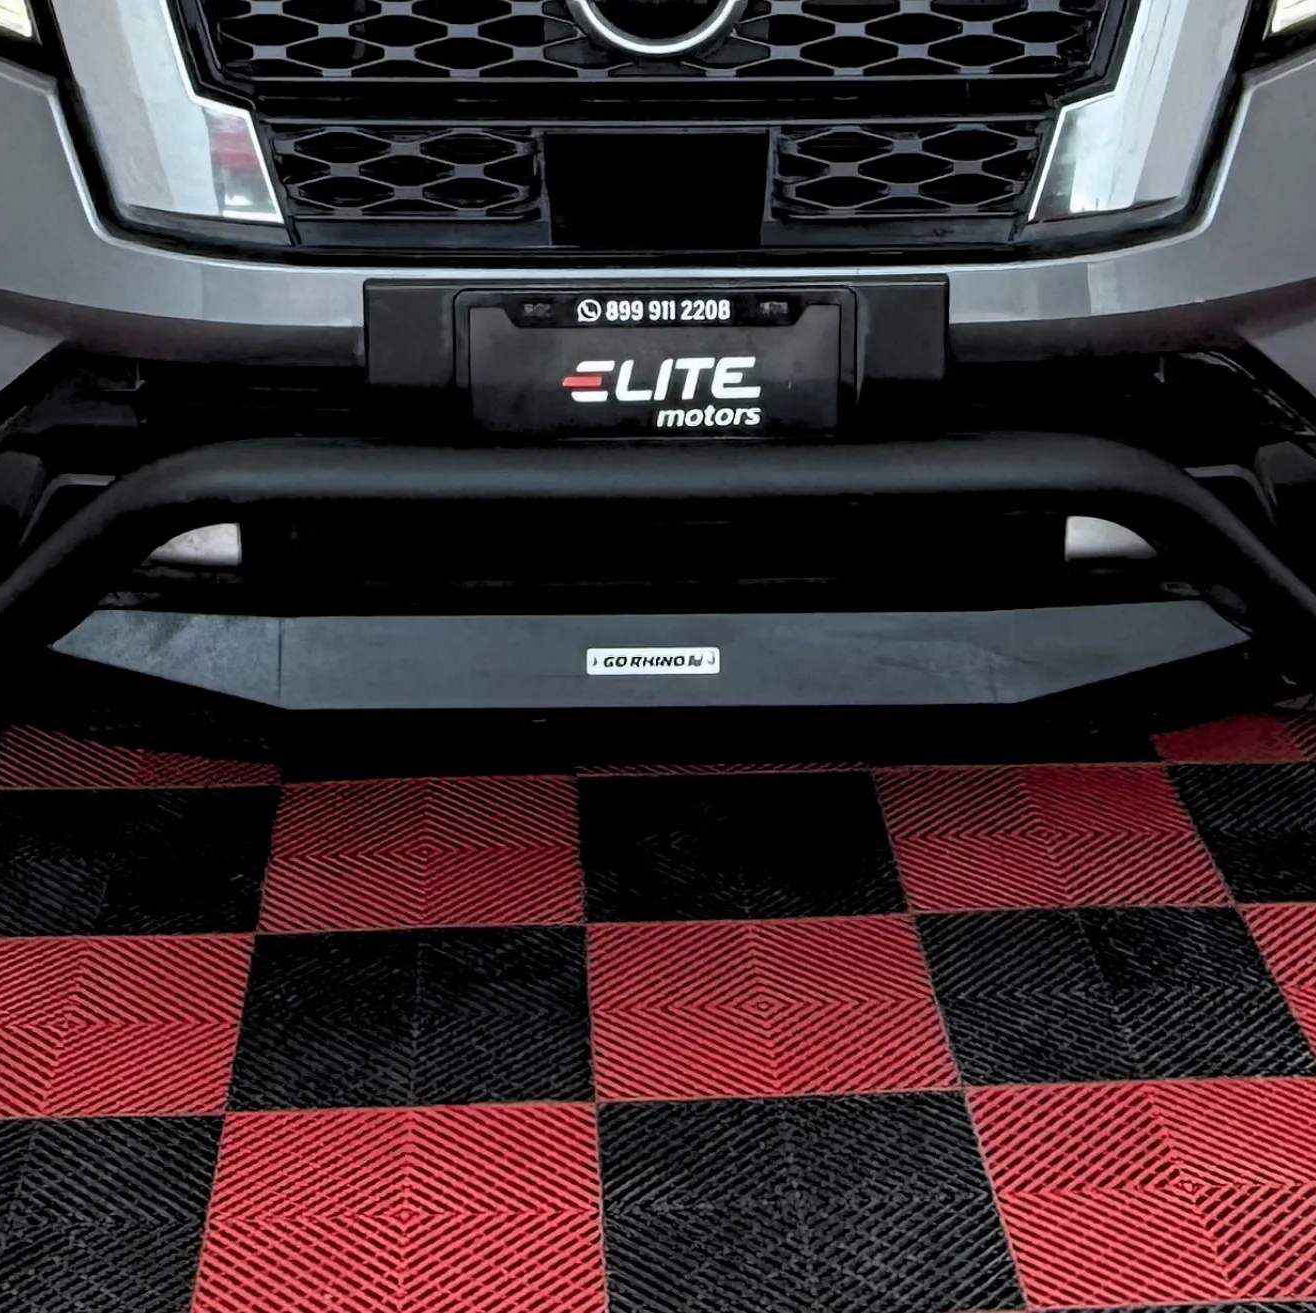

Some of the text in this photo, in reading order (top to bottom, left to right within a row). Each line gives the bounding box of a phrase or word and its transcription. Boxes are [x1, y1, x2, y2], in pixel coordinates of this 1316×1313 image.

[605, 298, 731, 321] 899 911 2208
[561, 356, 762, 403] ELITE
[656, 404, 762, 428] motors
